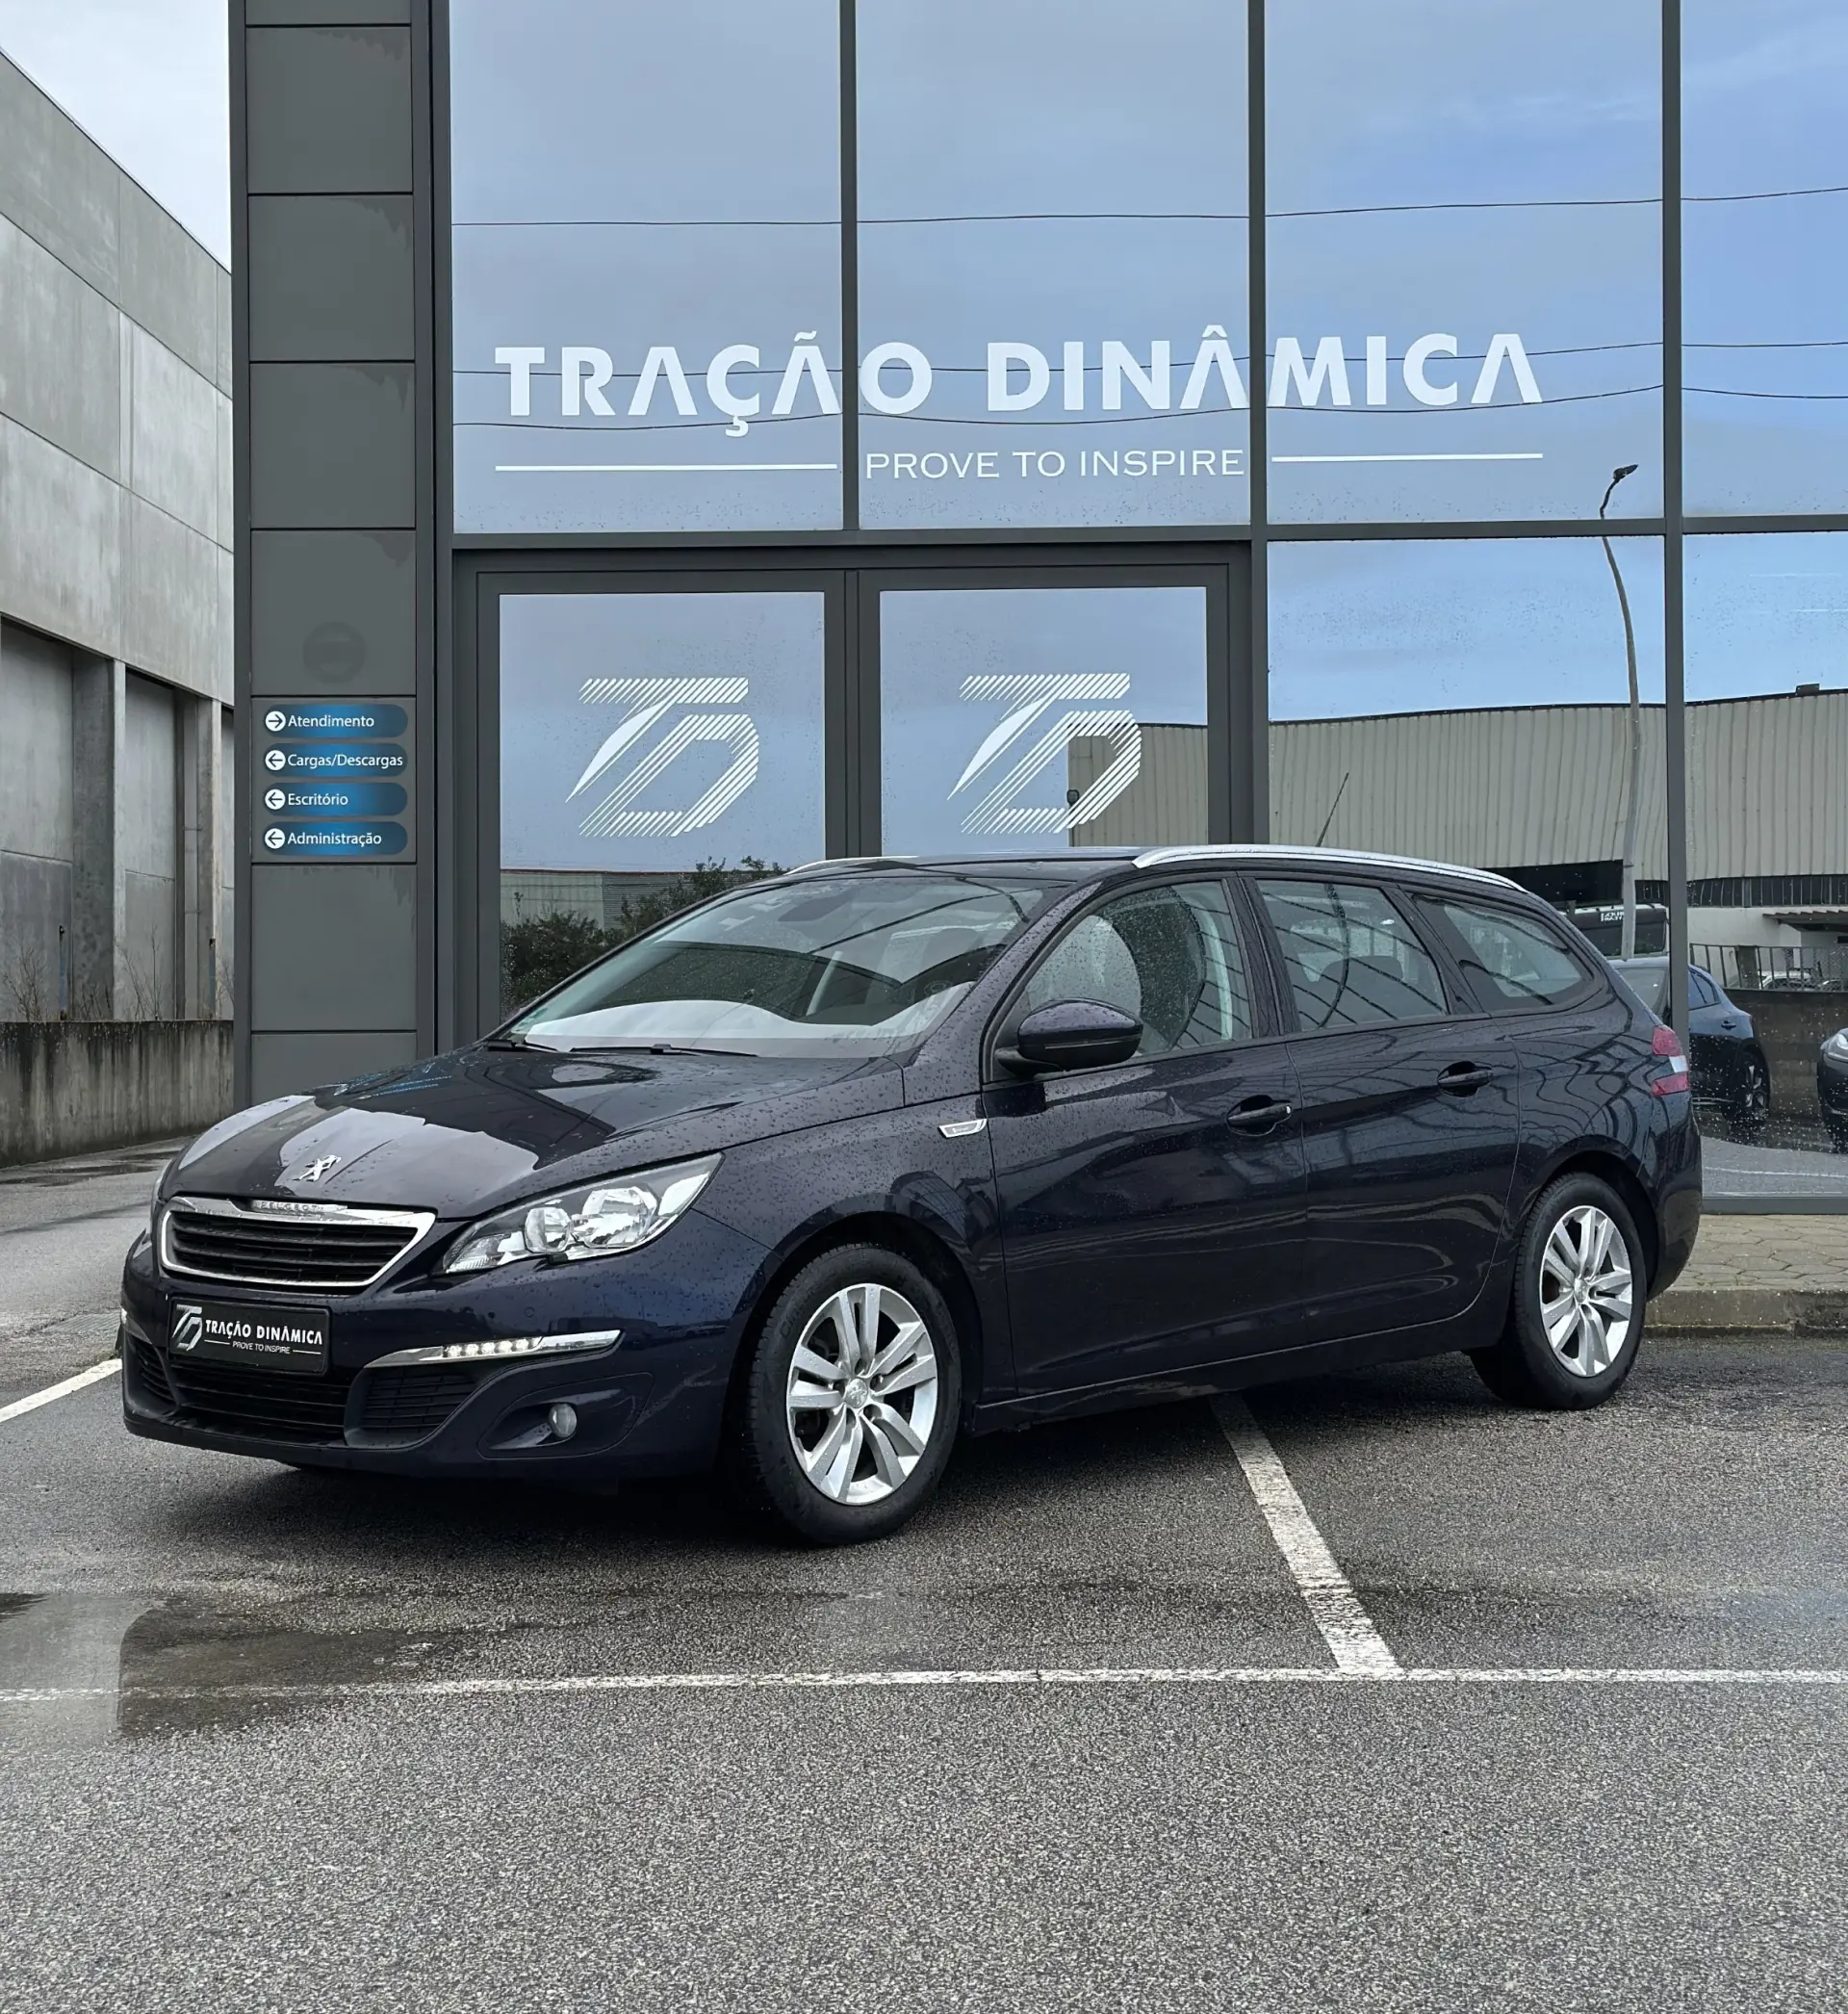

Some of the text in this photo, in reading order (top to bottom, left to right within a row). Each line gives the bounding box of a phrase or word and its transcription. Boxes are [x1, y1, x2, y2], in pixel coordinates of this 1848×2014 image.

[495, 324, 1543, 438] TRAÇÃO DINÂMICA
[865, 449, 1245, 479] PROVE TO INSPIRE
[287, 714, 374, 727] Atendimento
[287, 754, 403, 768] Cargas/Descargas
[288, 792, 348, 806] Escritório
[286, 833, 382, 847] Administração
[205, 1319, 322, 1345] TRAÇÃO DINÂMICA
[232, 1340, 291, 1355] PROVE TO INSPIRE
